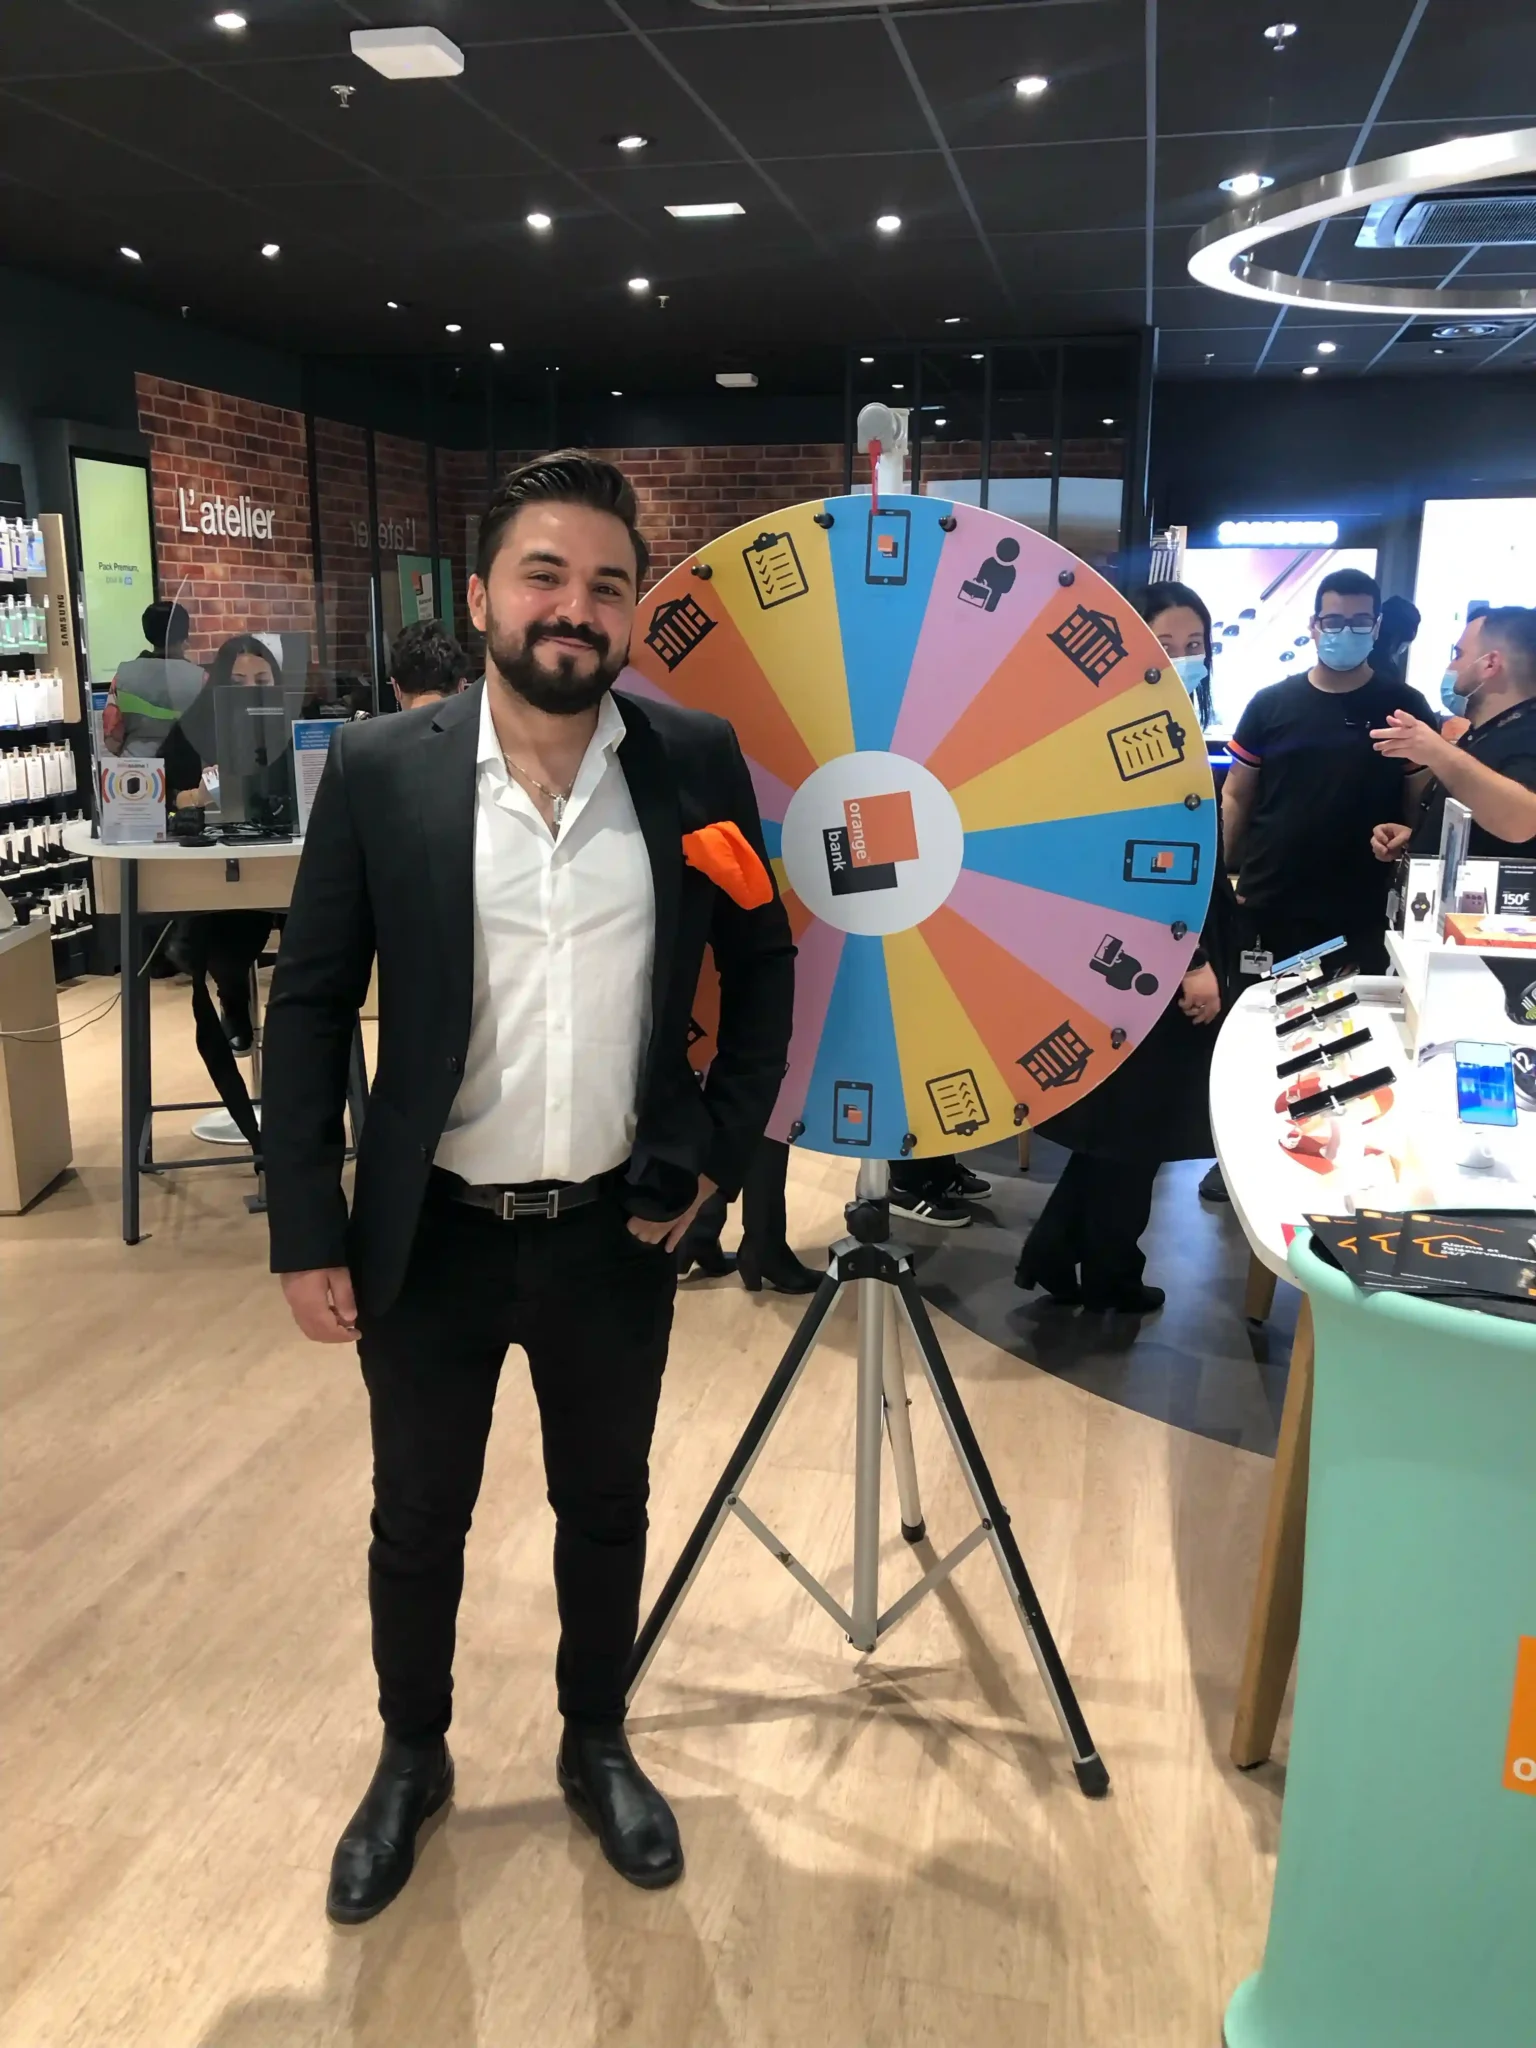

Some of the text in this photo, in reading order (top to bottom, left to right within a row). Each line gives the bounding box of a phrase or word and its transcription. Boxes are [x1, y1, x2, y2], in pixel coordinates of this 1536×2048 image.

[178, 486, 276, 540] L'atelier
[98, 561, 113, 571] Pack
[57, 594, 69, 646] SAMSUNG
[828, 831, 846, 871] bank
[849, 802, 867, 860] orange
[1501, 892, 1530, 905] 150€
